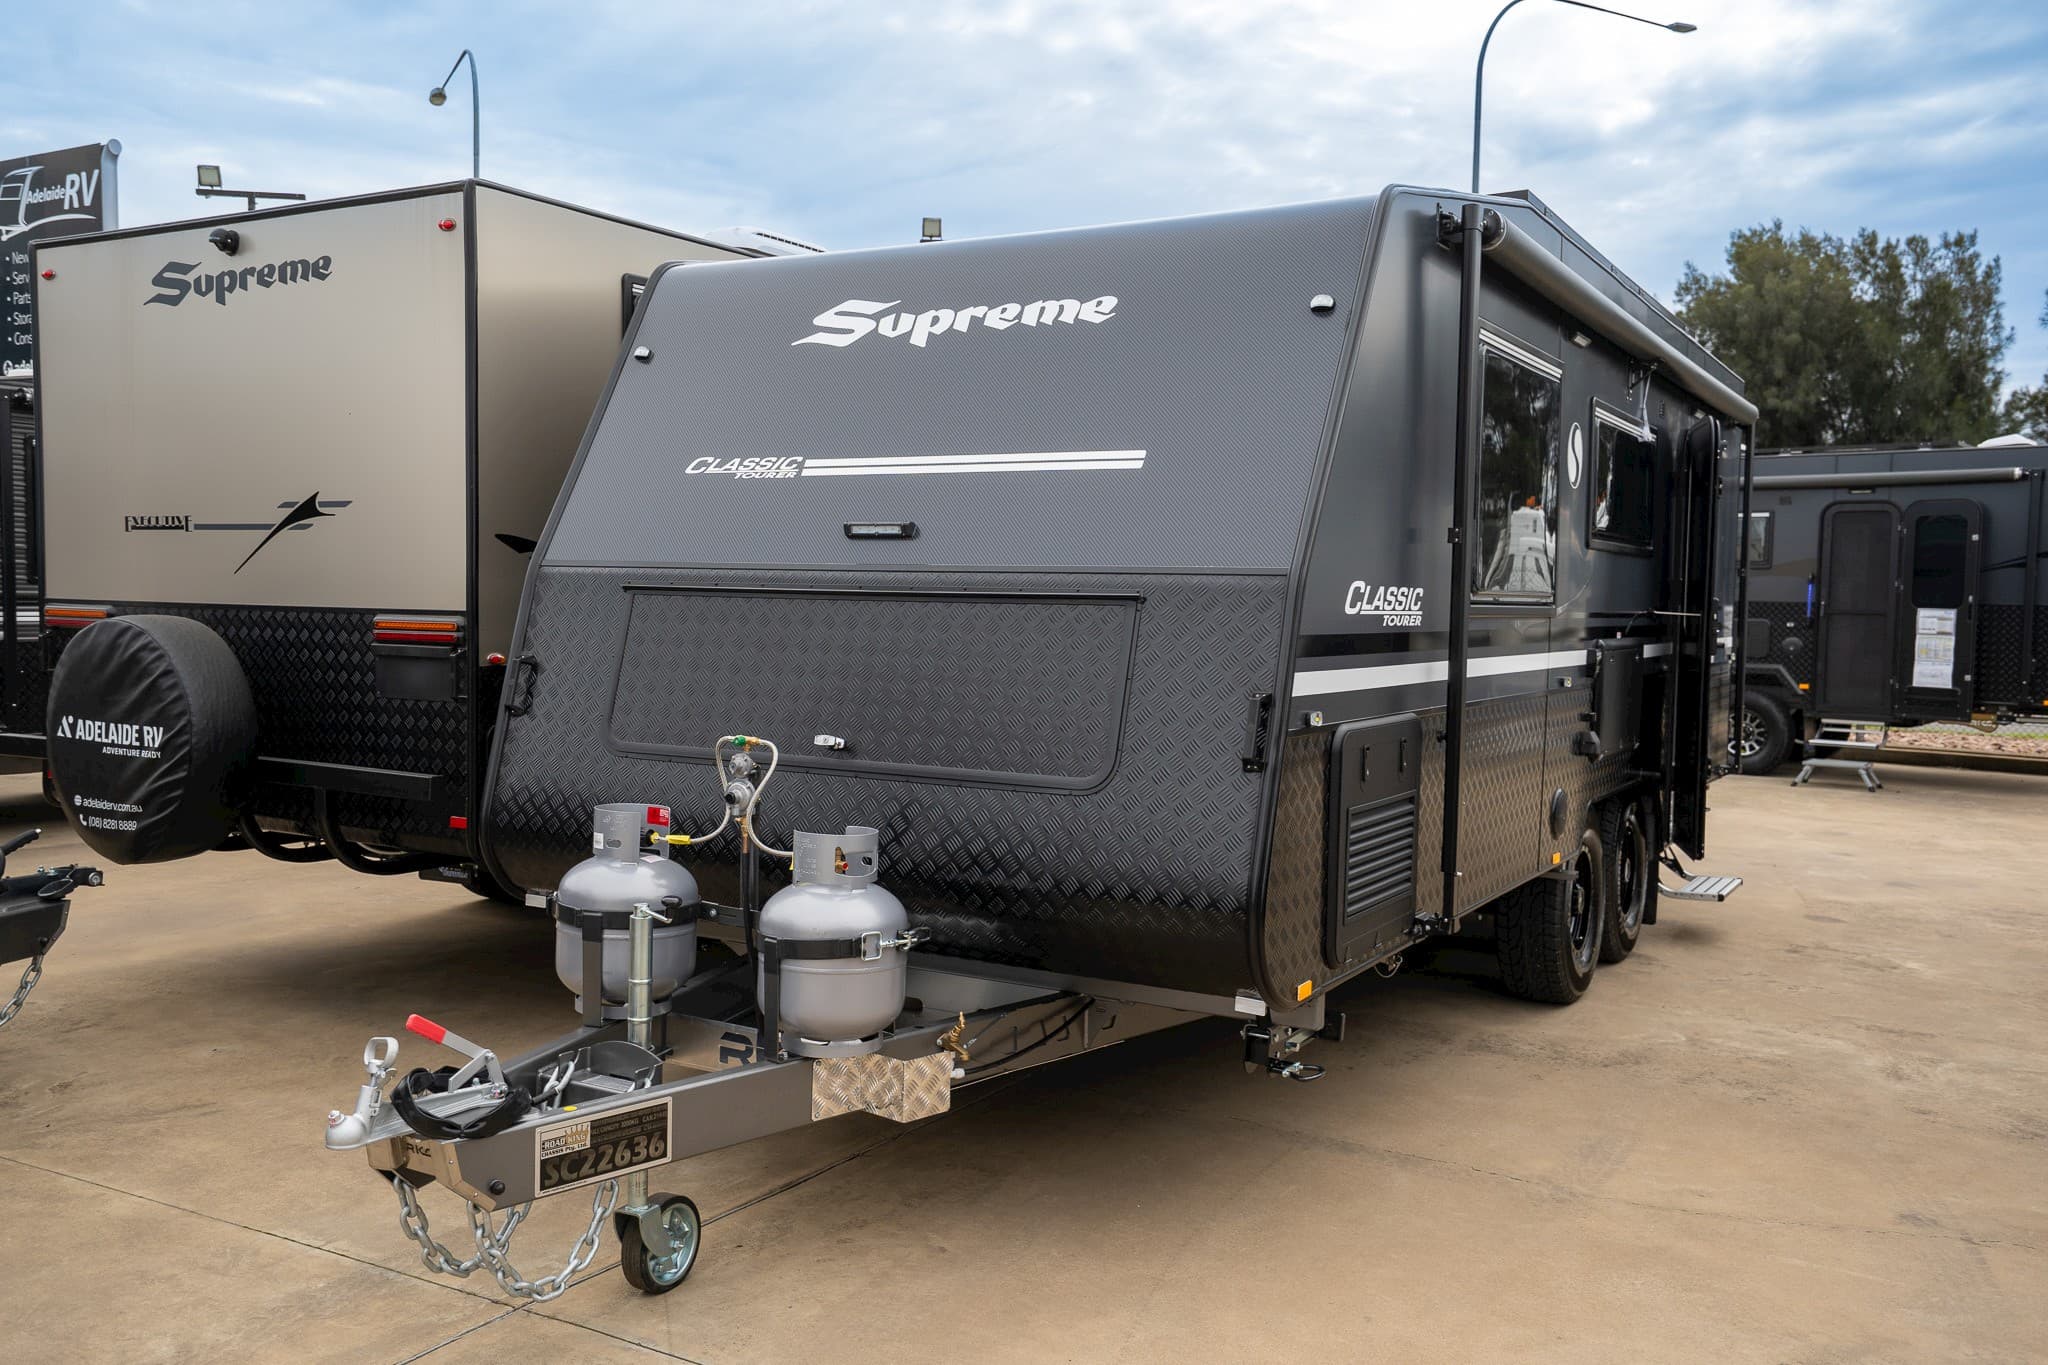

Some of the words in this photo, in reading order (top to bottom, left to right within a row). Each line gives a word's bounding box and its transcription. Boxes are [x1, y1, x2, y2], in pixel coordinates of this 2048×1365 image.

[26, 184, 65, 205] Adelaide
[64, 169, 99, 210] RV
[143, 255, 333, 307] Supreme
[791, 295, 1119, 348] Supreme
[125, 515, 193, 532] EXECUTIVE
[1383, 615, 1422, 627] TOURER
[75, 718, 140, 746] ADELAIDE
[143, 725, 164, 748] RV
[102, 746, 140, 757] ADVENTURE
[141, 750, 161, 759] READY
[82, 796, 143, 812] adelaiderv.com.au
[545, 1137, 565, 1149] ROAD
[544, 1131, 665, 1187] SC22636
